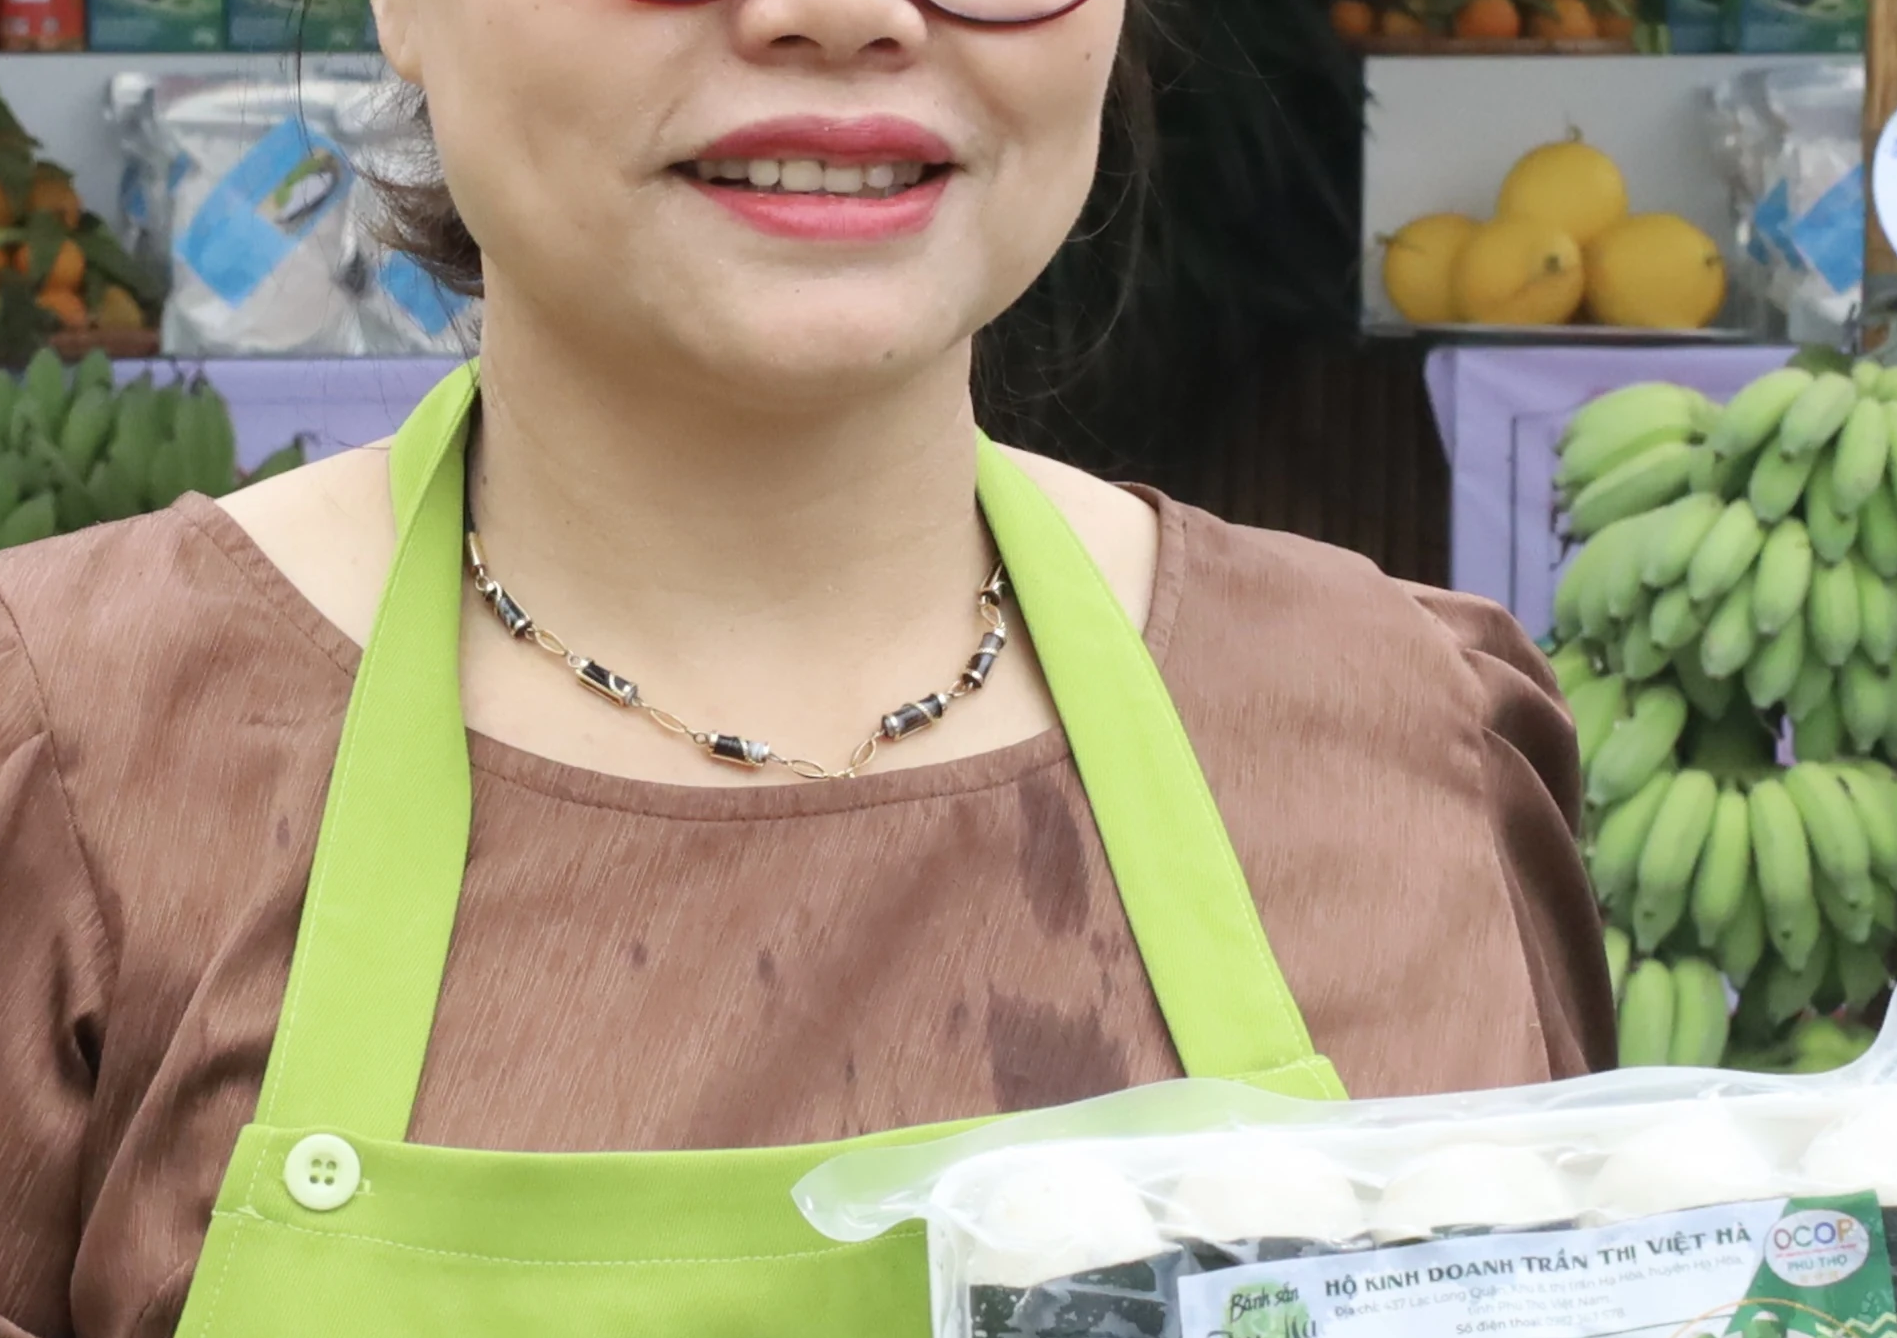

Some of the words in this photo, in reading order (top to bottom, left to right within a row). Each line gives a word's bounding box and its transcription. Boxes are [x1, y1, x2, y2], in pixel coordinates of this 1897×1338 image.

[1773, 1218, 1854, 1250] OCOP
[1325, 1274, 1358, 1300] HỘ
[1365, 1269, 1421, 1293] KINH
[1427, 1258, 1514, 1284] DOANH
[1520, 1248, 1589, 1273] TRẦN
[1597, 1245, 1638, 1266] THỊ
[1645, 1231, 1708, 1257] VIỆT
[1715, 1224, 1753, 1246] HÀ
[1817, 1253, 1848, 1270] THỌ
[1230, 1286, 1272, 1324] Bánh
